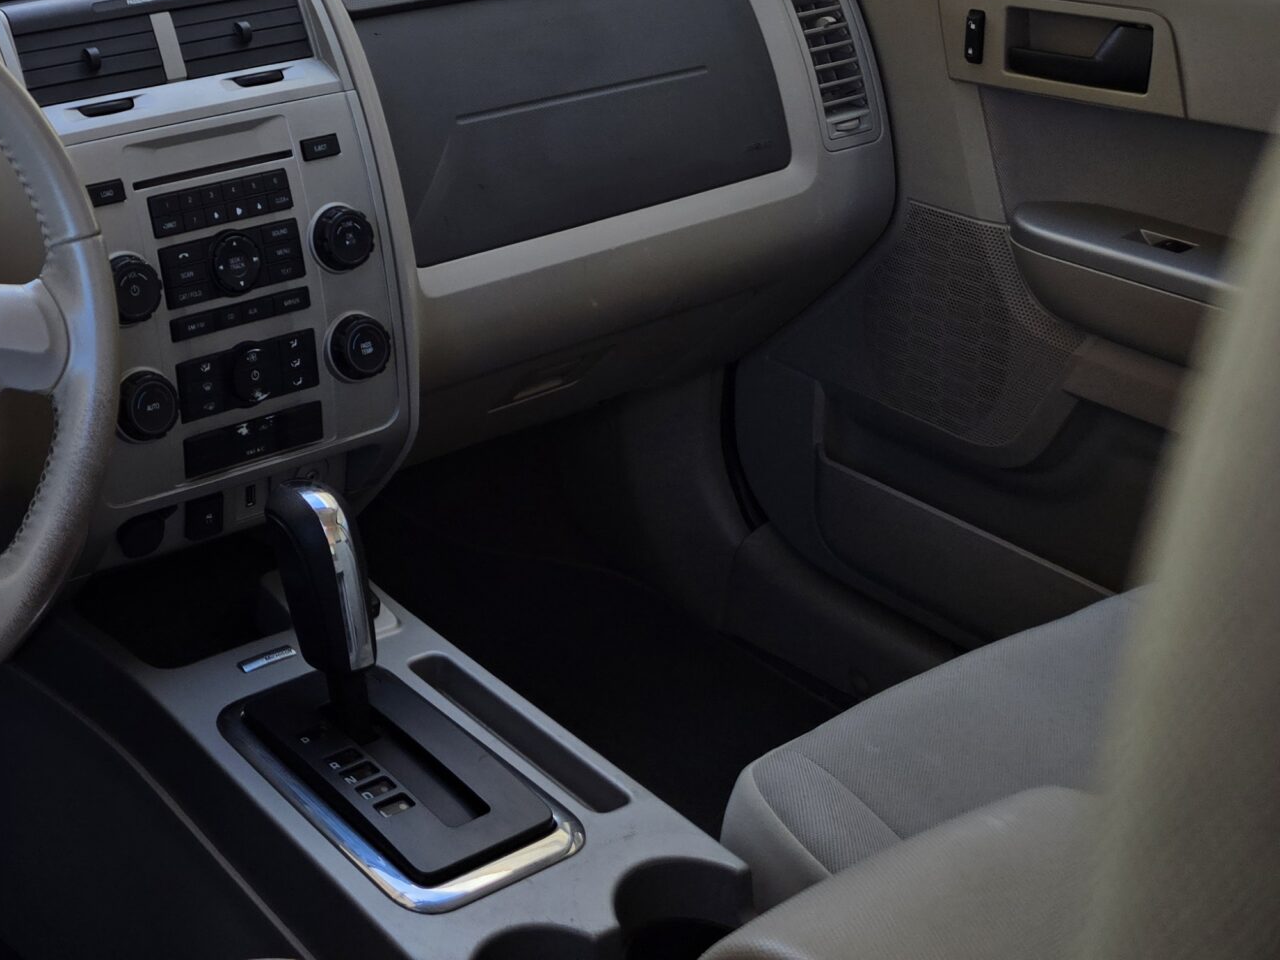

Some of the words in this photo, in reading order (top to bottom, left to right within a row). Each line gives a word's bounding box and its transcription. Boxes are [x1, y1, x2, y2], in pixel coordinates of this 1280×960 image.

[99, 189, 114, 198] LOAD
[271, 228, 288, 237] SOUND
[180, 271, 194, 279] SCAN
[147, 402, 160, 411] AUTO
[329, 761, 341, 770] R
[344, 775, 357, 784] N
